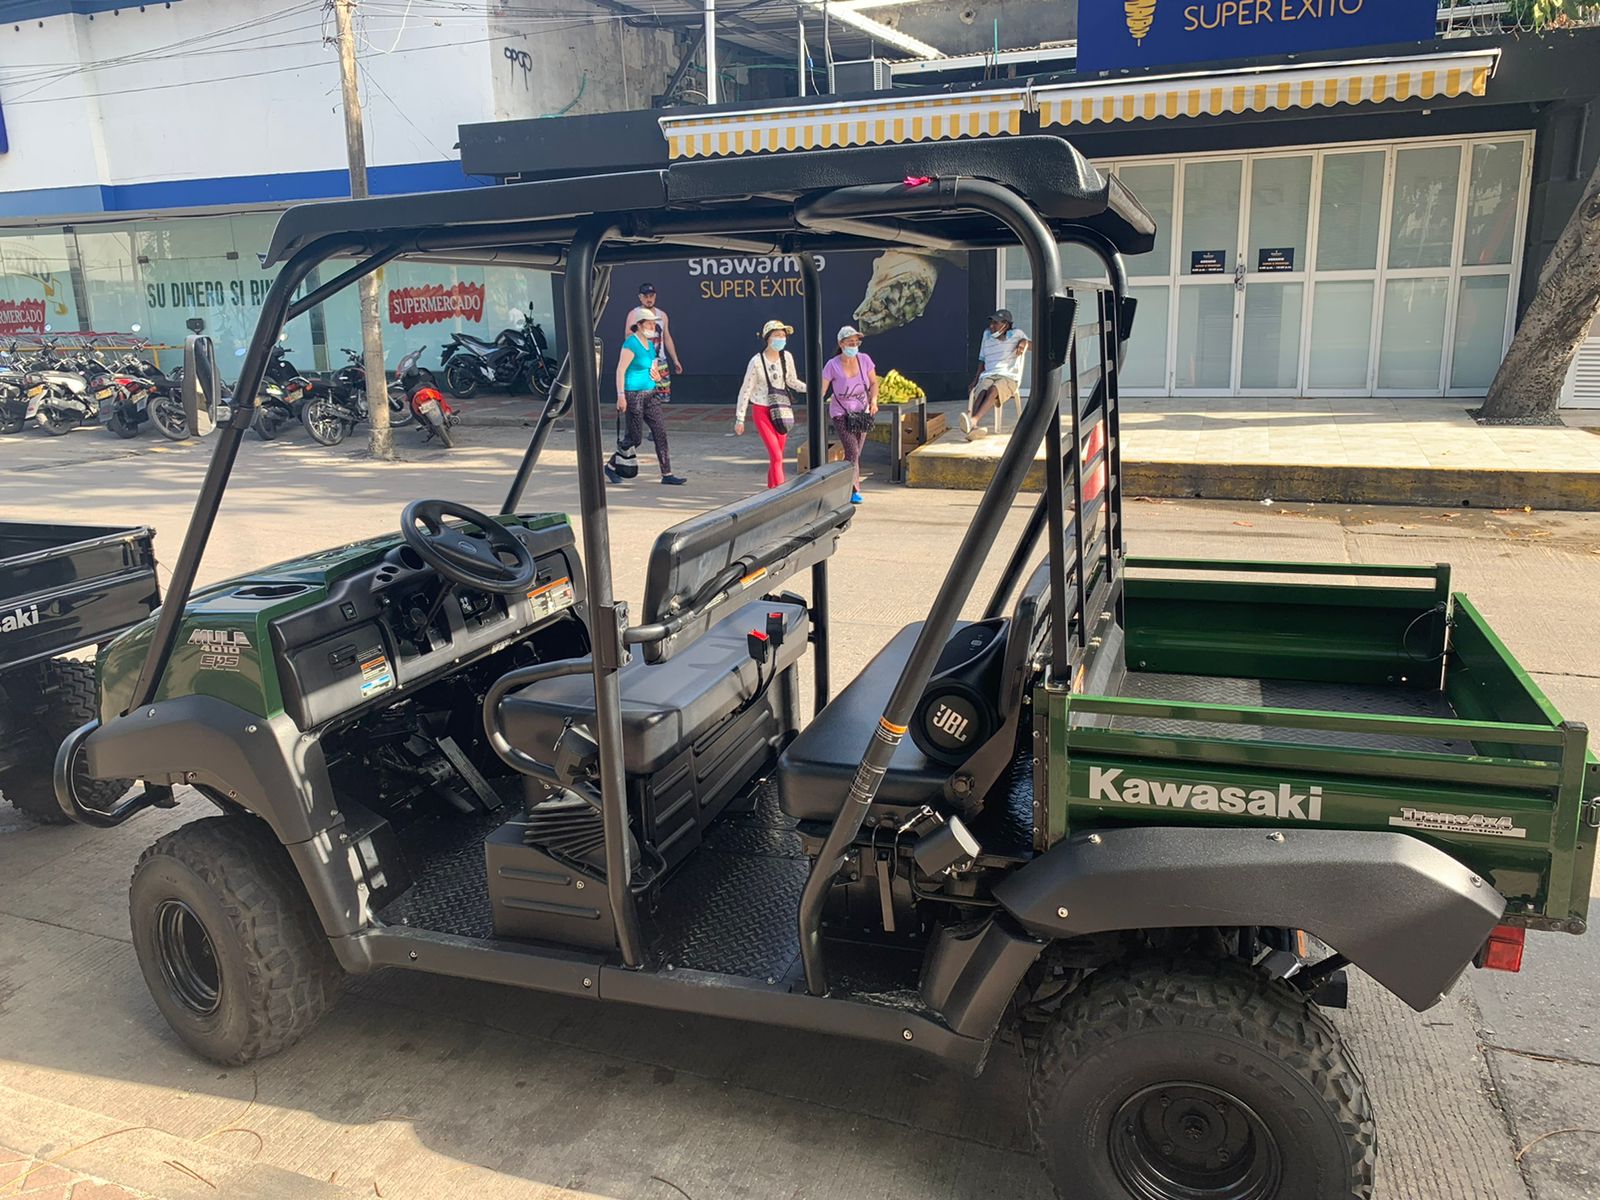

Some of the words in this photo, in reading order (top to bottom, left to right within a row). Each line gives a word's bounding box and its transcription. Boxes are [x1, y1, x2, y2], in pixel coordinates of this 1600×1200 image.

[1184, 0, 1273, 31] SUPER
[147, 283, 166, 308] SU
[171, 280, 225, 308] DINERO
[230, 280, 245, 306] SI
[701, 279, 757, 299] SUPER
[393, 295, 480, 315] SUPERMERCADO
[0, 604, 40, 633] aki
[187, 629, 253, 649] MULE
[201, 645, 240, 654] 4010
[932, 704, 969, 743] JBL
[1089, 766, 1323, 821] Kawasaki
[1400, 807, 1513, 831] Trans4x4
